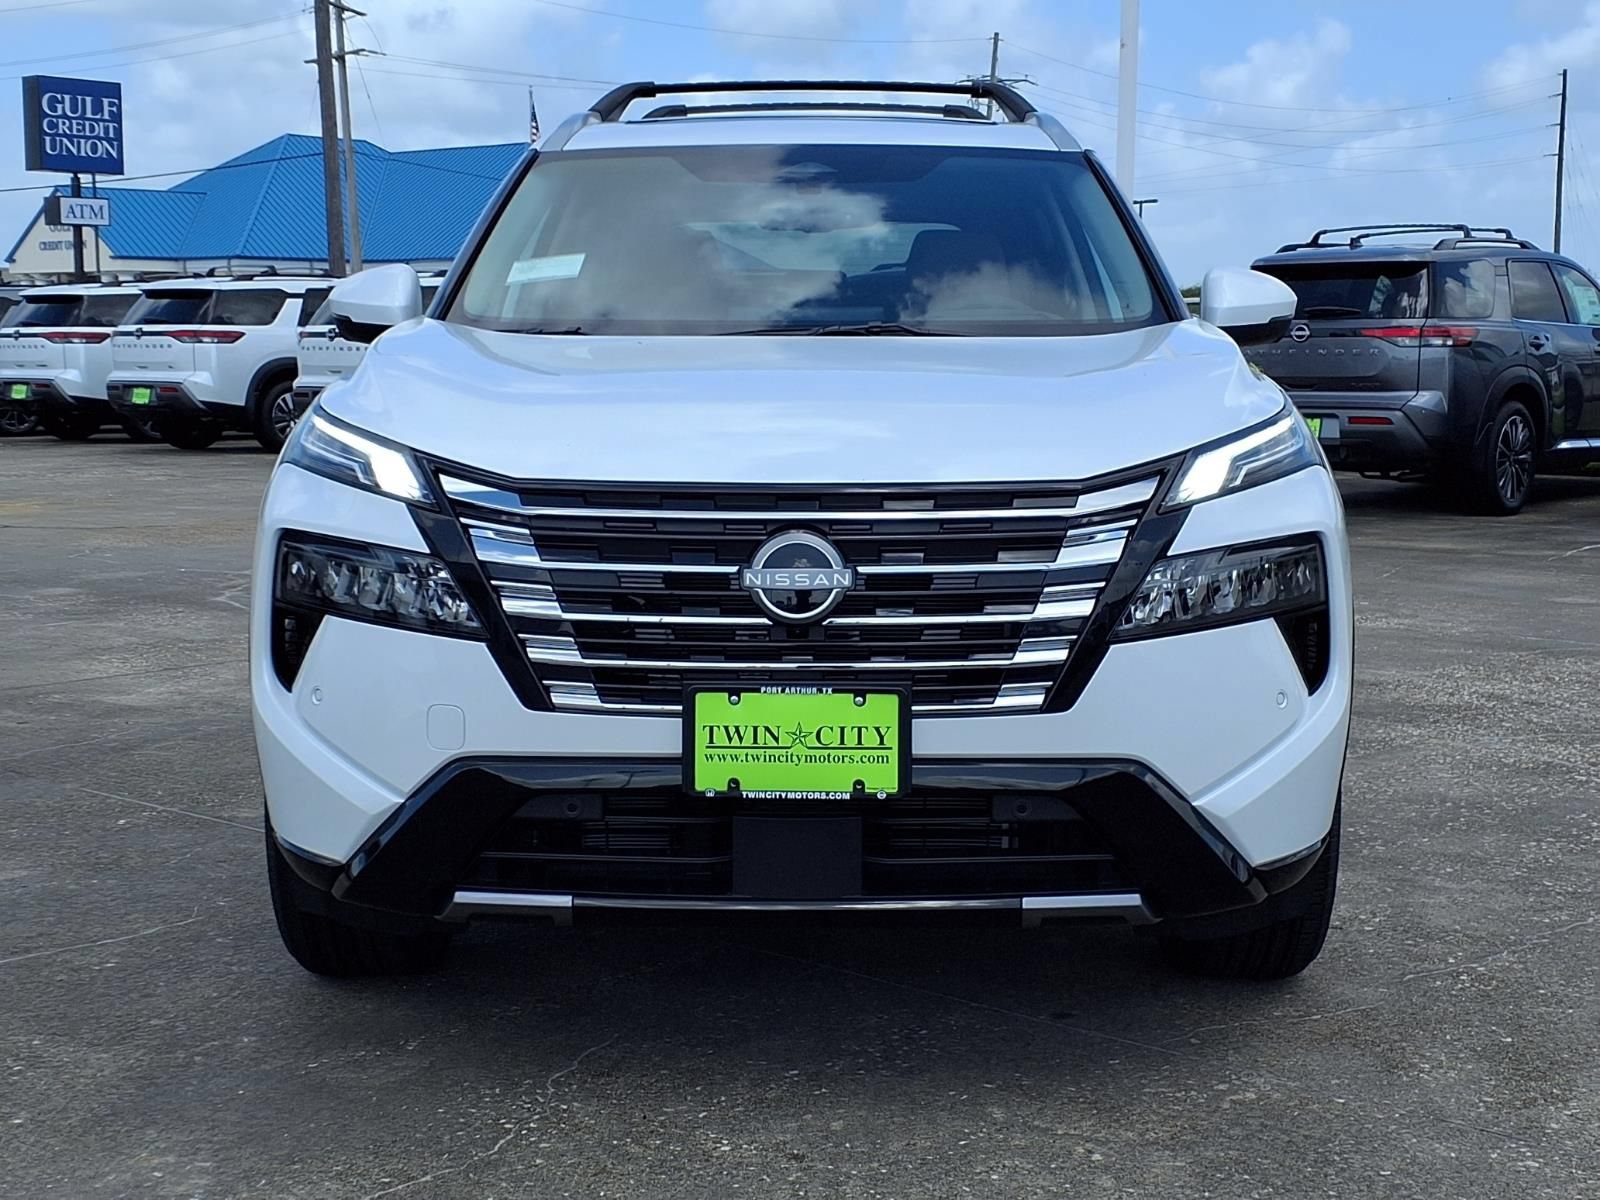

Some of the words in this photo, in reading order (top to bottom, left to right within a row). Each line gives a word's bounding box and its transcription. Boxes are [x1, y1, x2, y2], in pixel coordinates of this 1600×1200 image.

[41, 92, 118, 120] GULF
[42, 117, 118, 139] CREDIT
[43, 136, 118, 159] UNION
[65, 203, 105, 220] ATM
[745, 572, 850, 586] NISSAN
[760, 686, 783, 695] PORT
[822, 686, 834, 695] TX
[702, 725, 781, 746] TWIN
[815, 725, 893, 747] CITY
[704, 750, 890, 766] www.twincitymotors.com
[741, 791, 851, 800] TWINCITYMOTORS.COM
